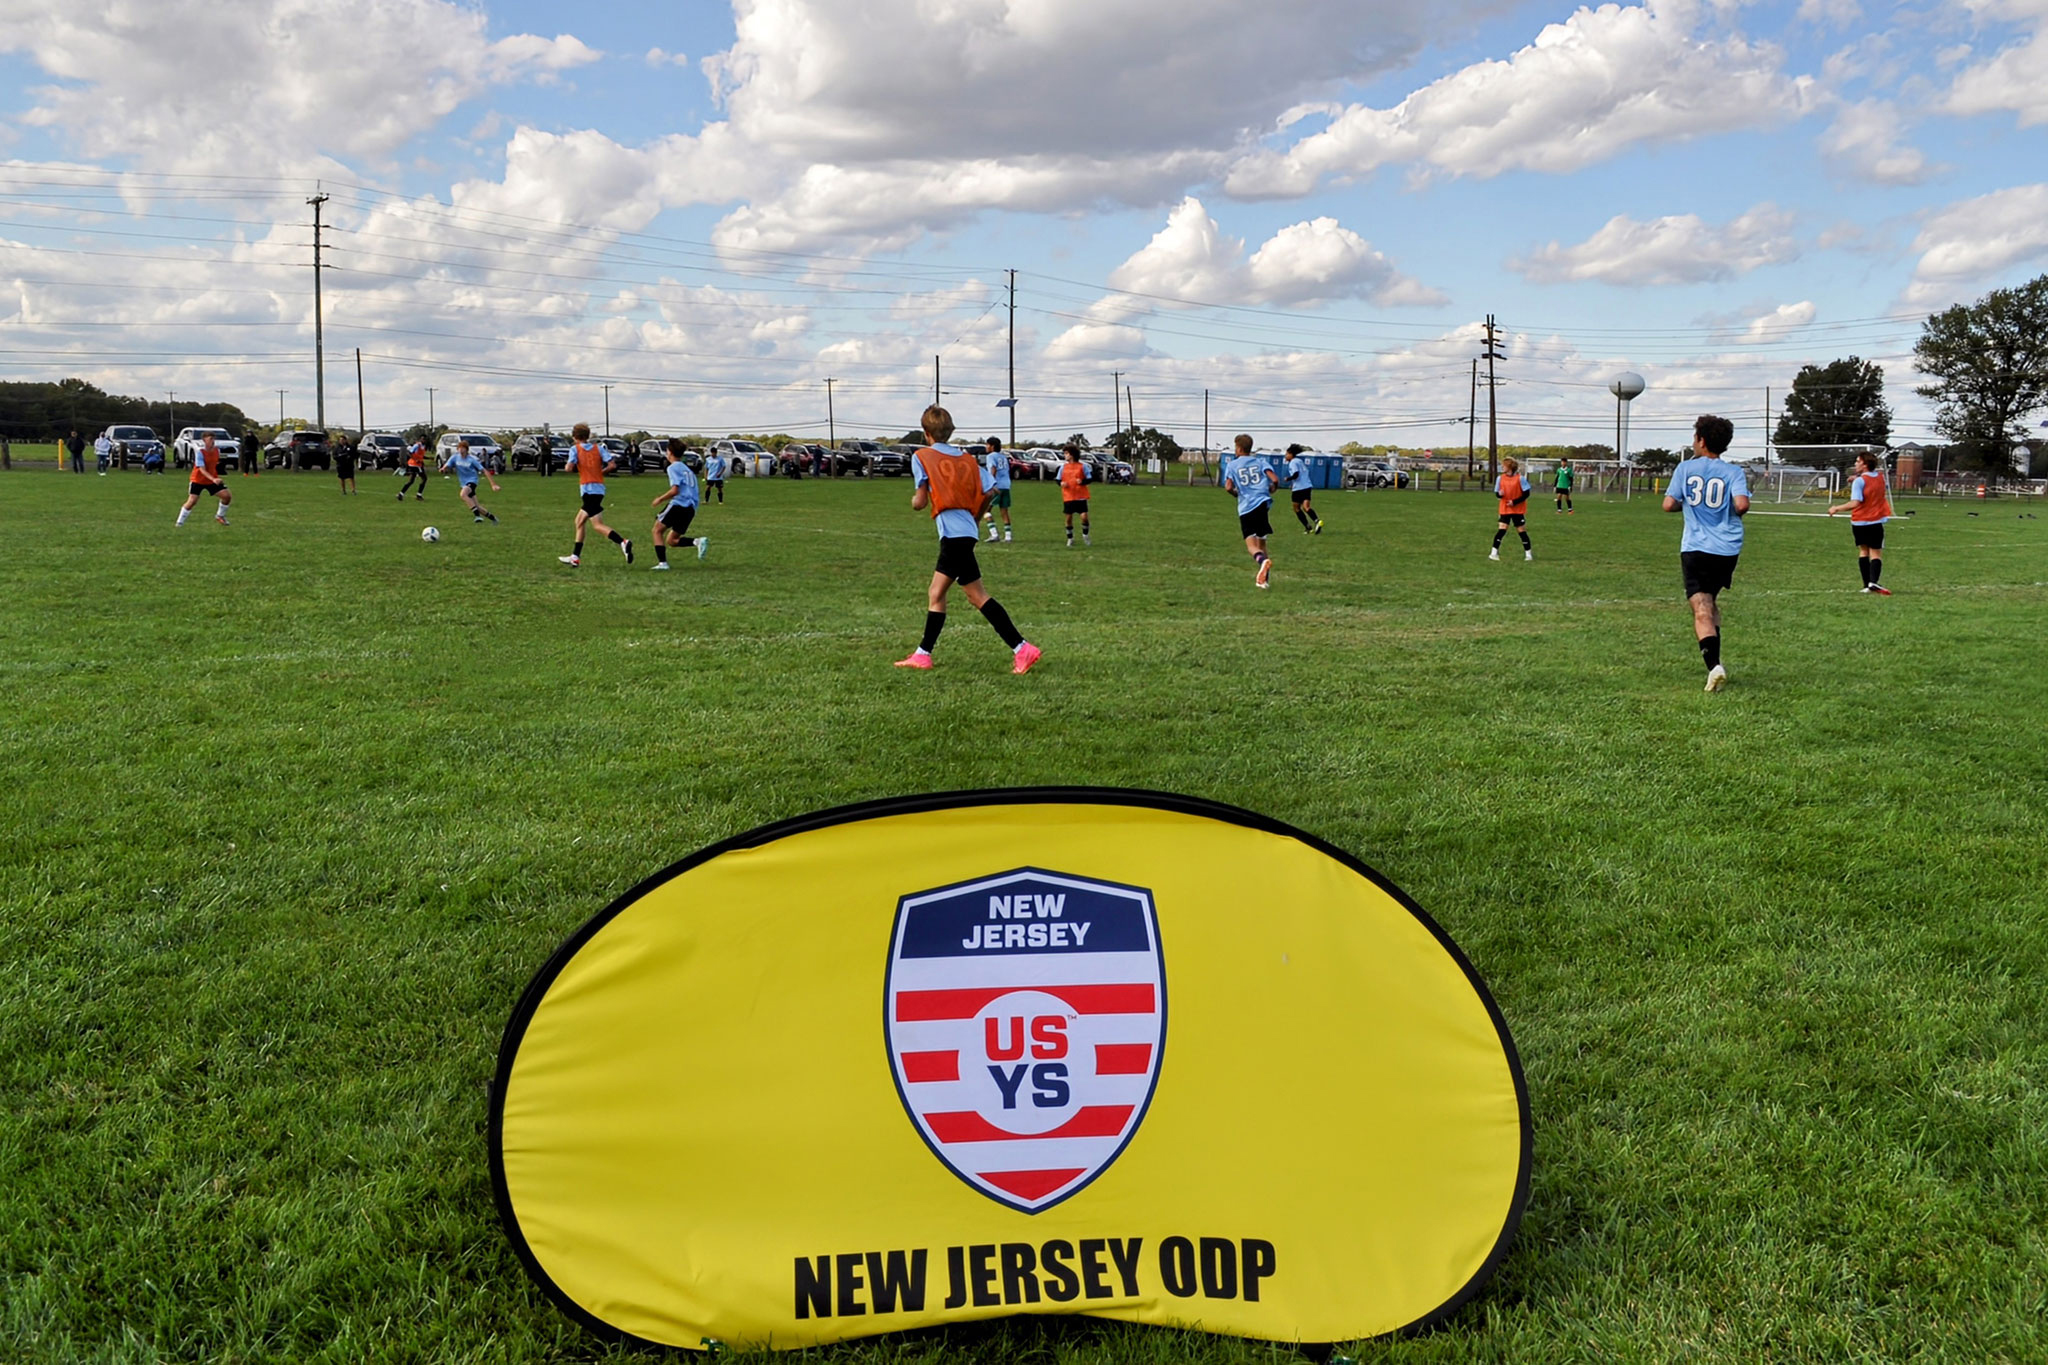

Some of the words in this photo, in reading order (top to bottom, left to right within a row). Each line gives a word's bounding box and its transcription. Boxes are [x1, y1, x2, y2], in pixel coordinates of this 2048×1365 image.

[1238, 465, 1260, 485] 55
[1686, 475, 1724, 508] 30
[988, 893, 1066, 919] NEW
[961, 921, 1091, 950] JERSEY
[984, 1014, 1069, 1062] US
[986, 1062, 1070, 1110] YS
[794, 1248, 928, 1320] NEW
[944, 1237, 1145, 1309] JERSEY
[1158, 1235, 1277, 1303] ODP
